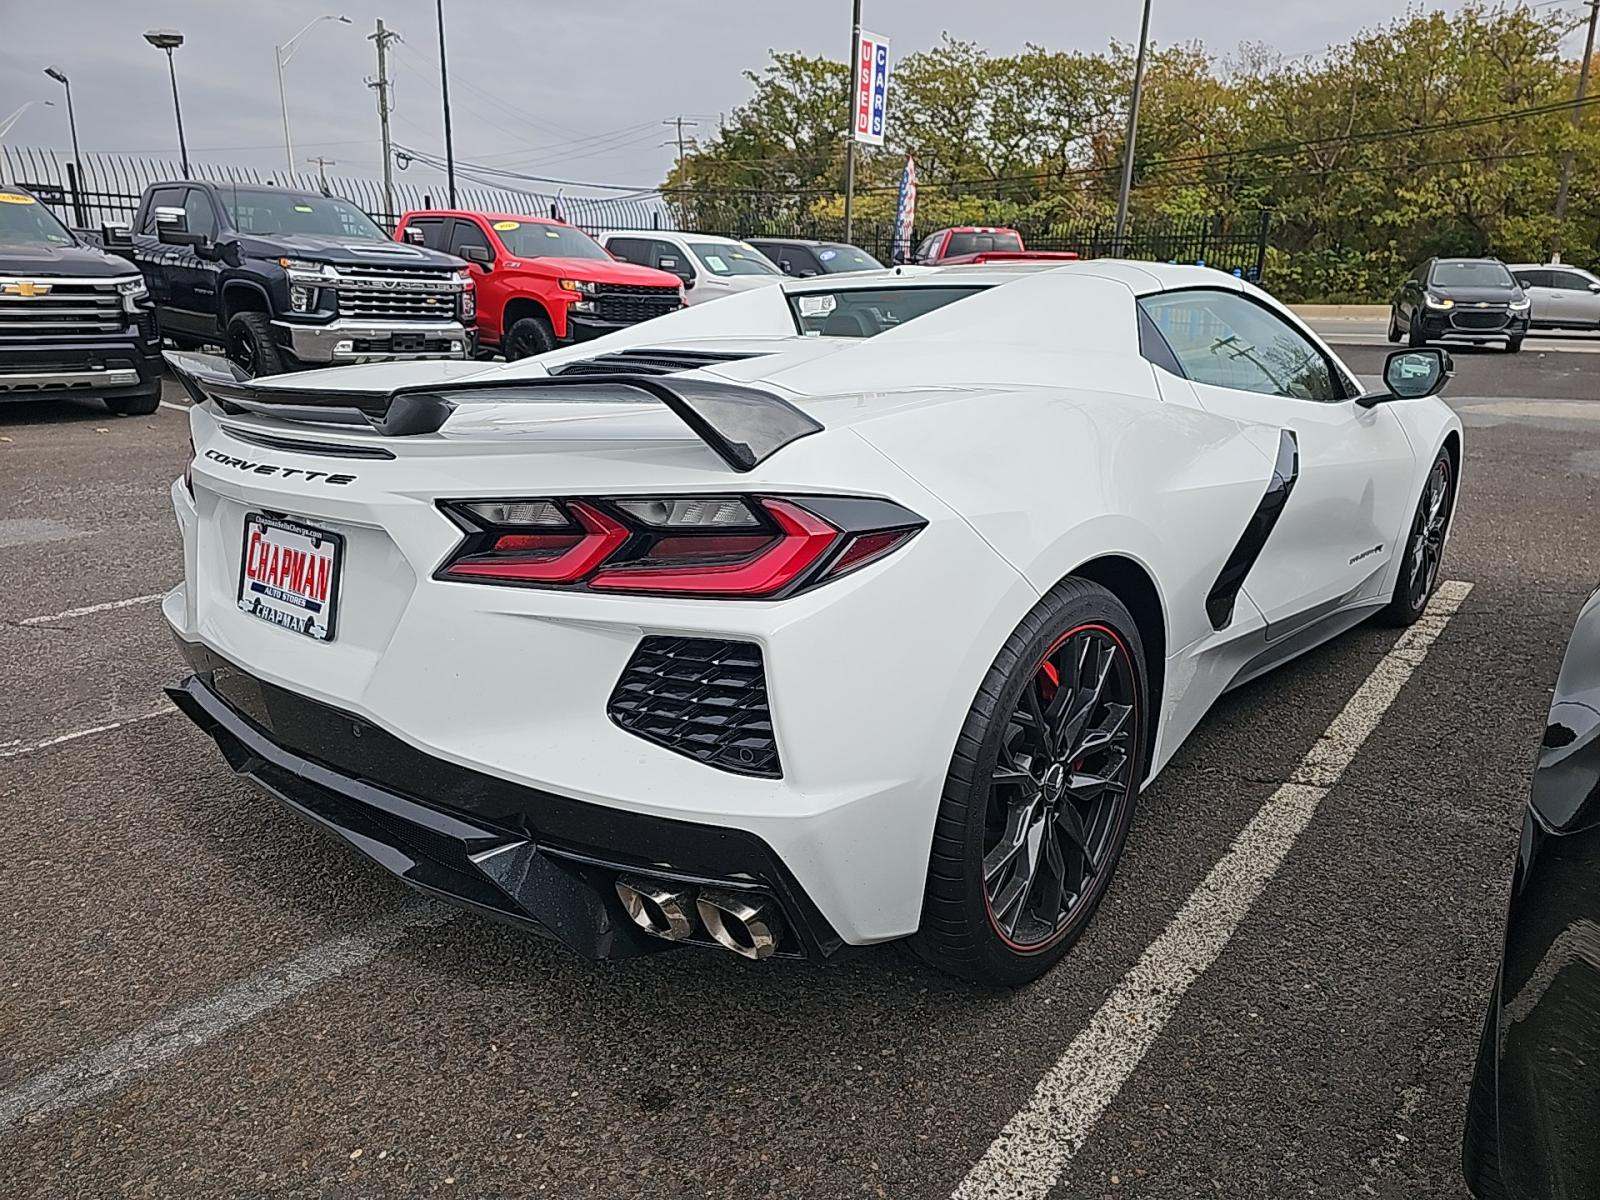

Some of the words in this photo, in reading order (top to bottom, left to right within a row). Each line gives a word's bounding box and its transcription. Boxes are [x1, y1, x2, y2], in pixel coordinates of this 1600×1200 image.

[859, 45, 871, 129] USED
[873, 49, 885, 132] CARS
[204, 449, 357, 485] CORVETTE
[247, 531, 332, 604] CHAPMAN
[256, 604, 306, 633] CHAPMAN
[264, 587, 282, 600] AUTO
[282, 593, 307, 608] STORES
